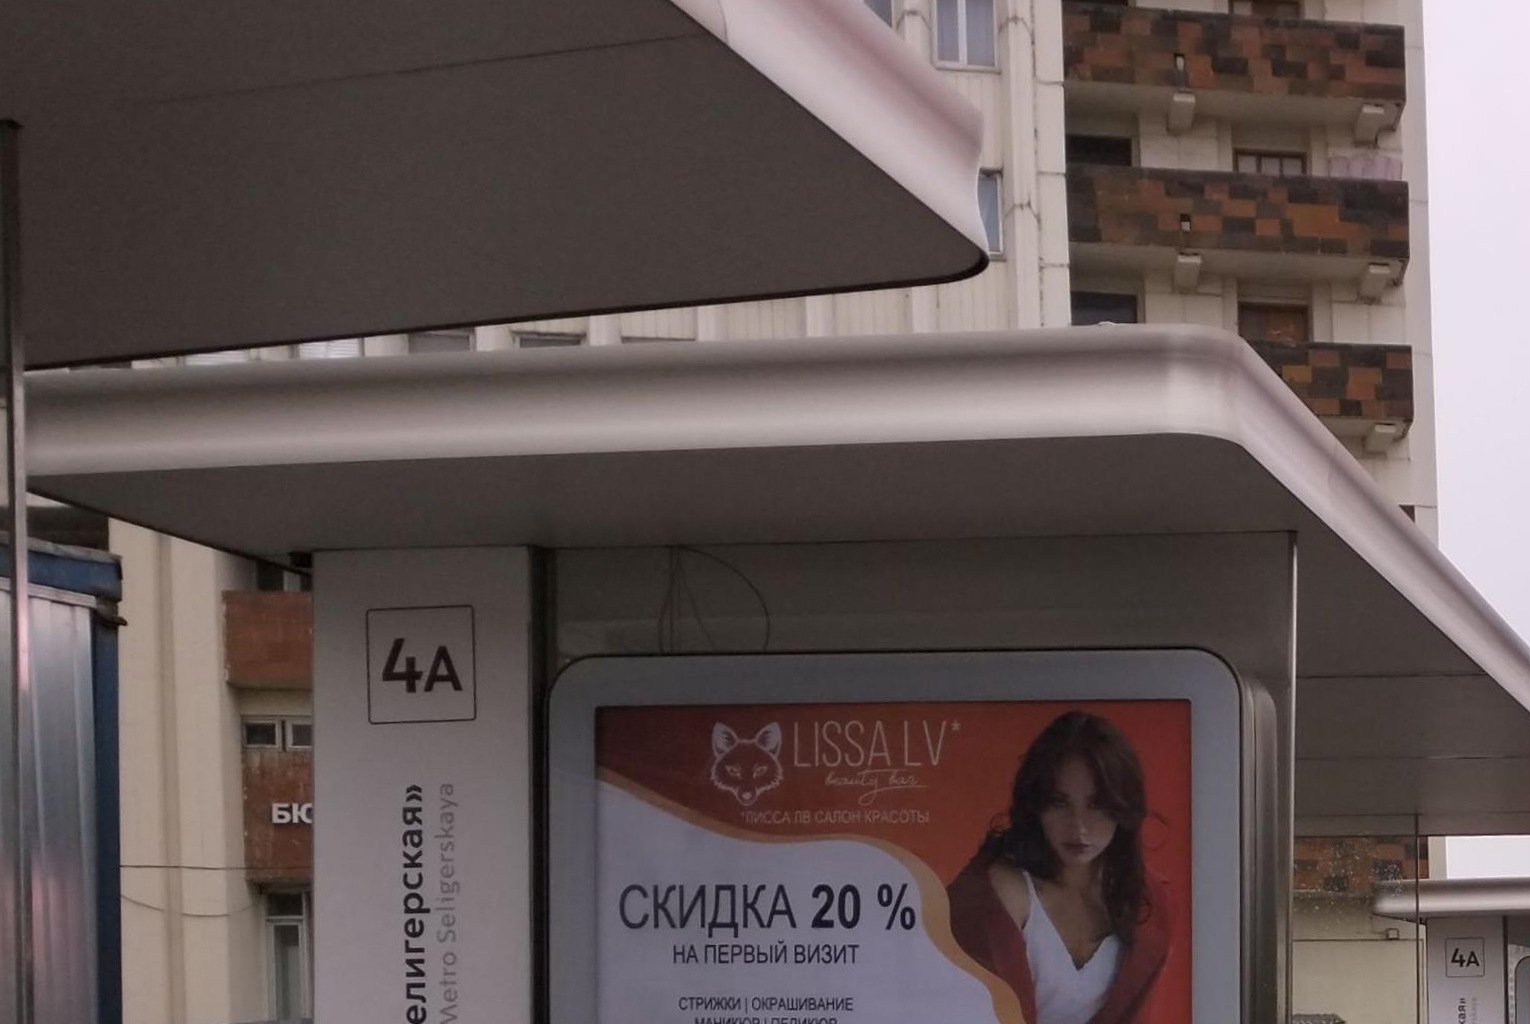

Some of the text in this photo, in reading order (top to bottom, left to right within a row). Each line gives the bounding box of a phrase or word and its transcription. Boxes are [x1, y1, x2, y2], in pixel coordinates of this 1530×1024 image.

[381, 637, 464, 695] 4А
[793, 720, 891, 767] LISSA
[814, 810, 861, 825] САЛОН
[864, 810, 930, 825] КРАСОТЫ
[434, 782, 462, 945] Seligerskaya
[618, 883, 916, 938] СКИДКА 20 %
[673, 940, 860, 965] НА ПЕРВЫЙ ВИЗИТ
[1450, 948, 1481, 968] 4А
[678, 997, 741, 1011] СТРИЖКИ
[751, 997, 854, 1012] ОКРАШИВАНИЕ
